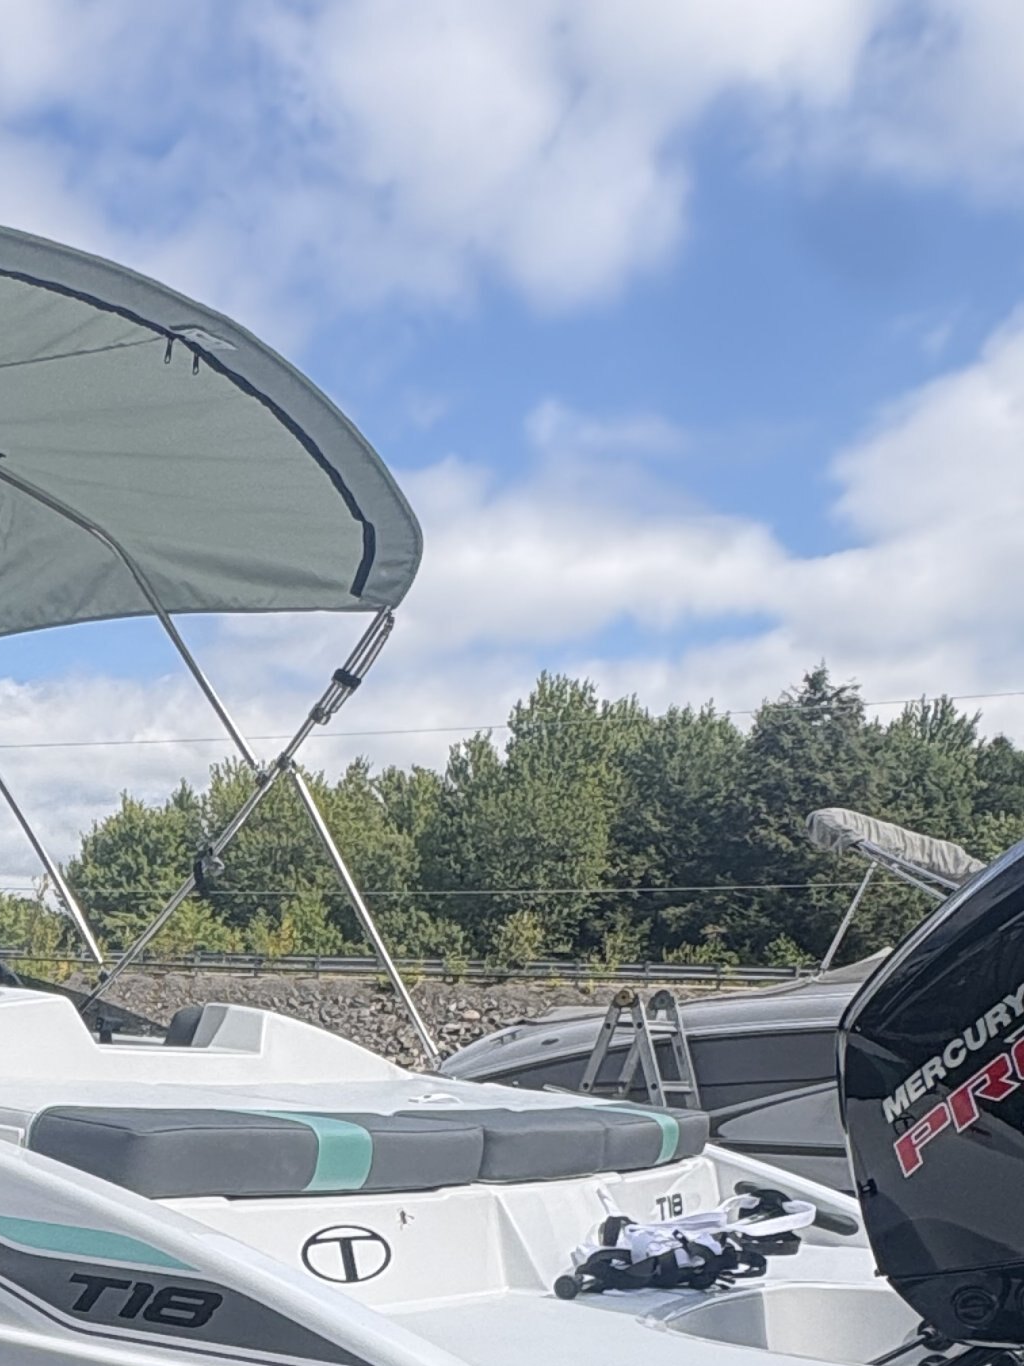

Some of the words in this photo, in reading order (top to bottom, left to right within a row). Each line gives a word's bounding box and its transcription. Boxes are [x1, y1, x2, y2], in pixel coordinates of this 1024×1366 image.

[882, 983, 1024, 1124] MERCURY
[894, 1036, 1024, 1178] PR
[655, 1193, 683, 1221] T18
[69, 1272, 224, 1329] T18
